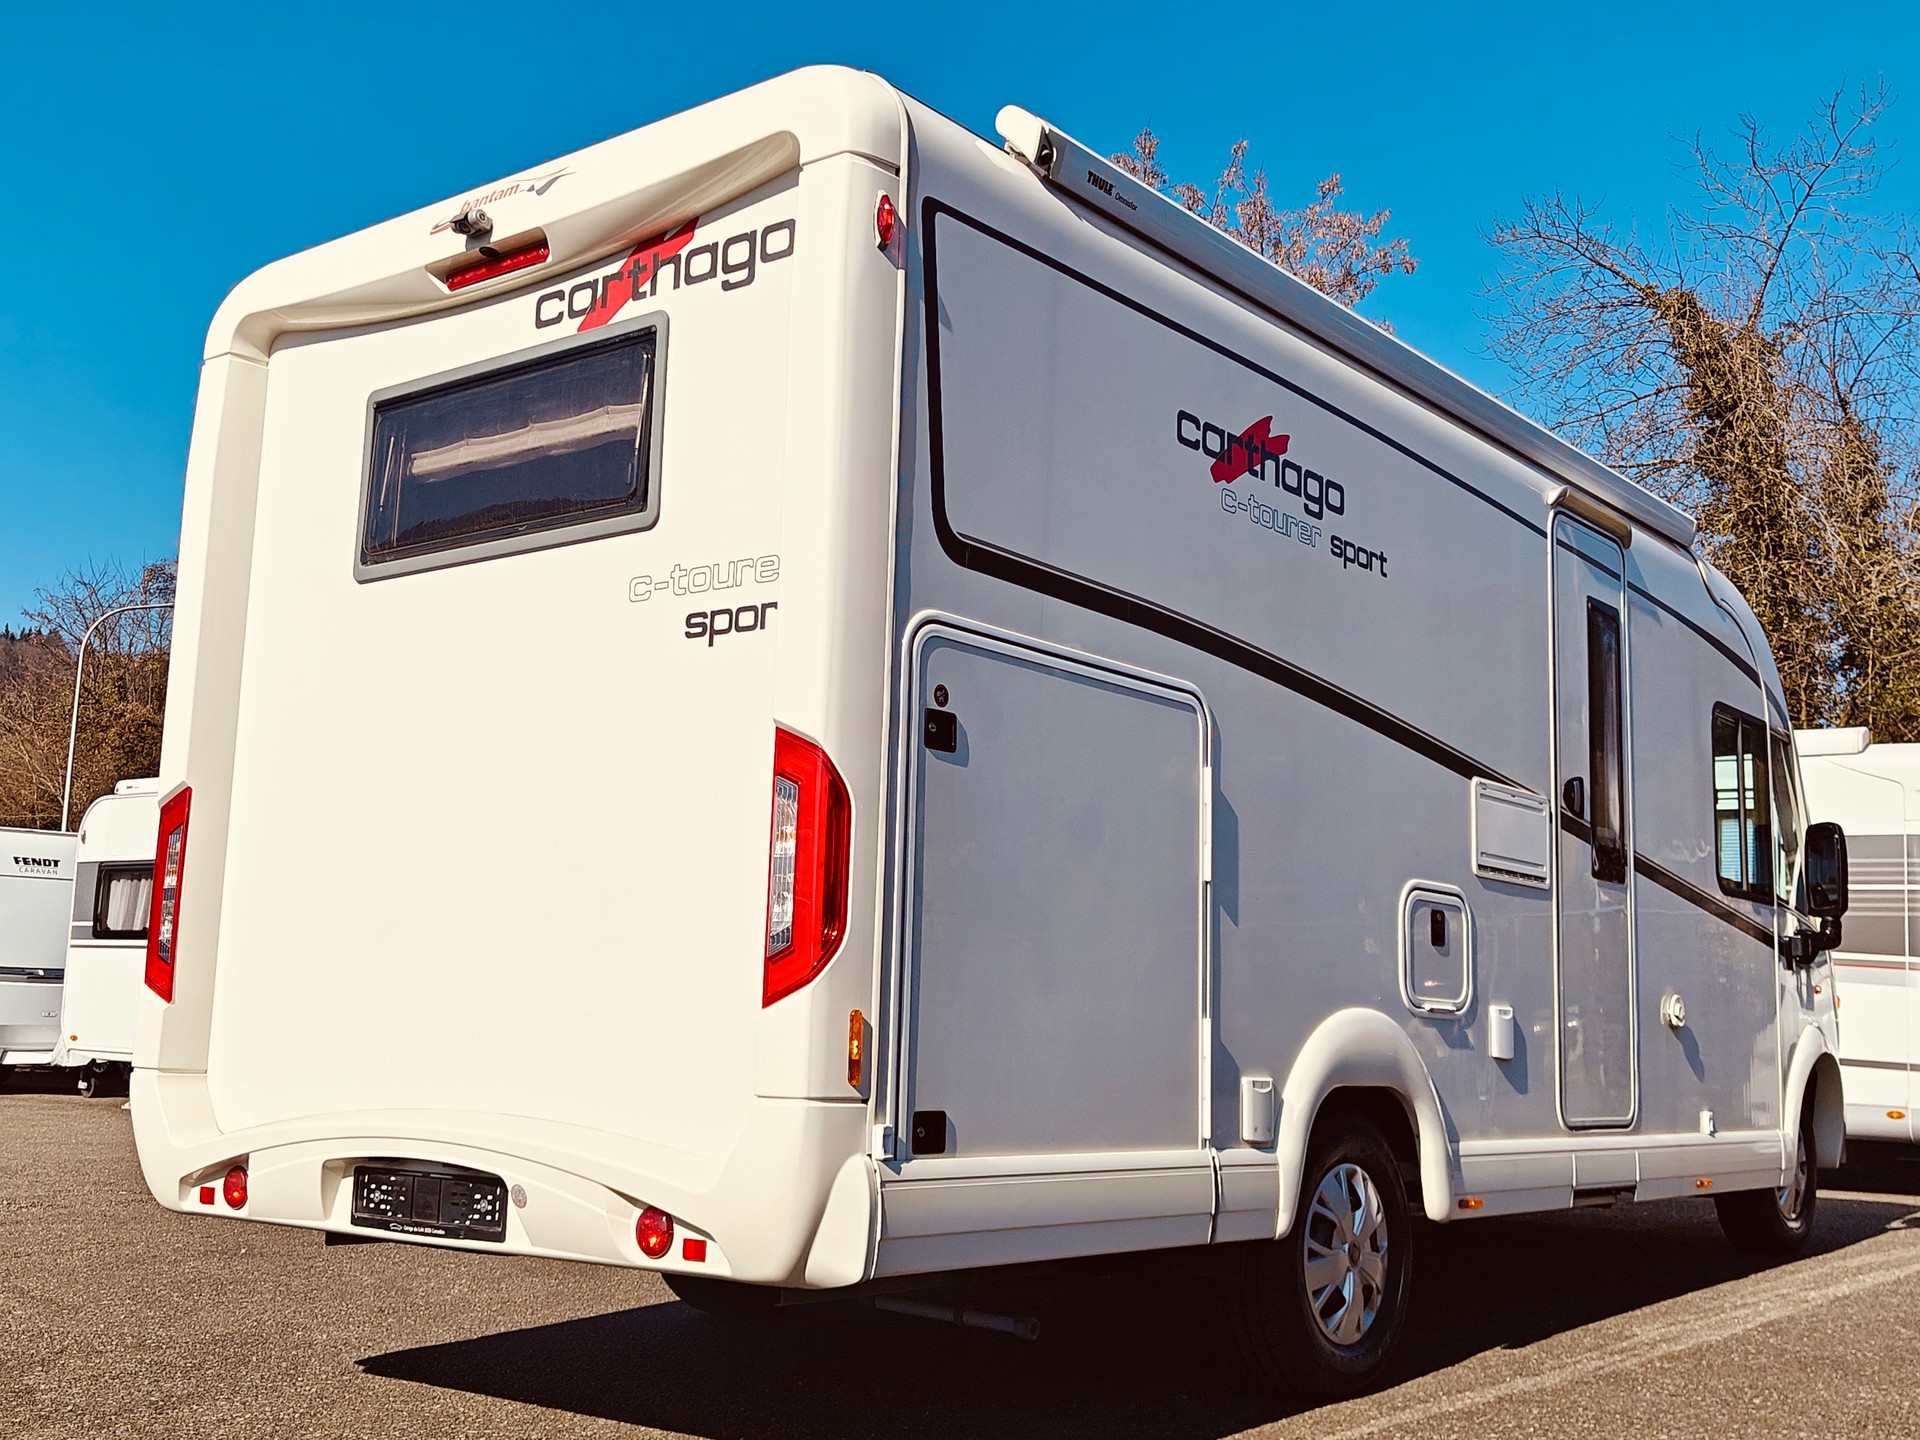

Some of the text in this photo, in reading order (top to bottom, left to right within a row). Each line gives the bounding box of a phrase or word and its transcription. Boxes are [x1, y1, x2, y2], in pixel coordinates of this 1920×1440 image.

[1087, 170, 1115, 196] THULE
[535, 218, 796, 329] carthago
[1177, 409, 1345, 520] carthago
[1221, 488, 1387, 578] c-tourer sport
[13, 856, 61, 867] FENDT
[18, 867, 58, 875] CARAVAN
